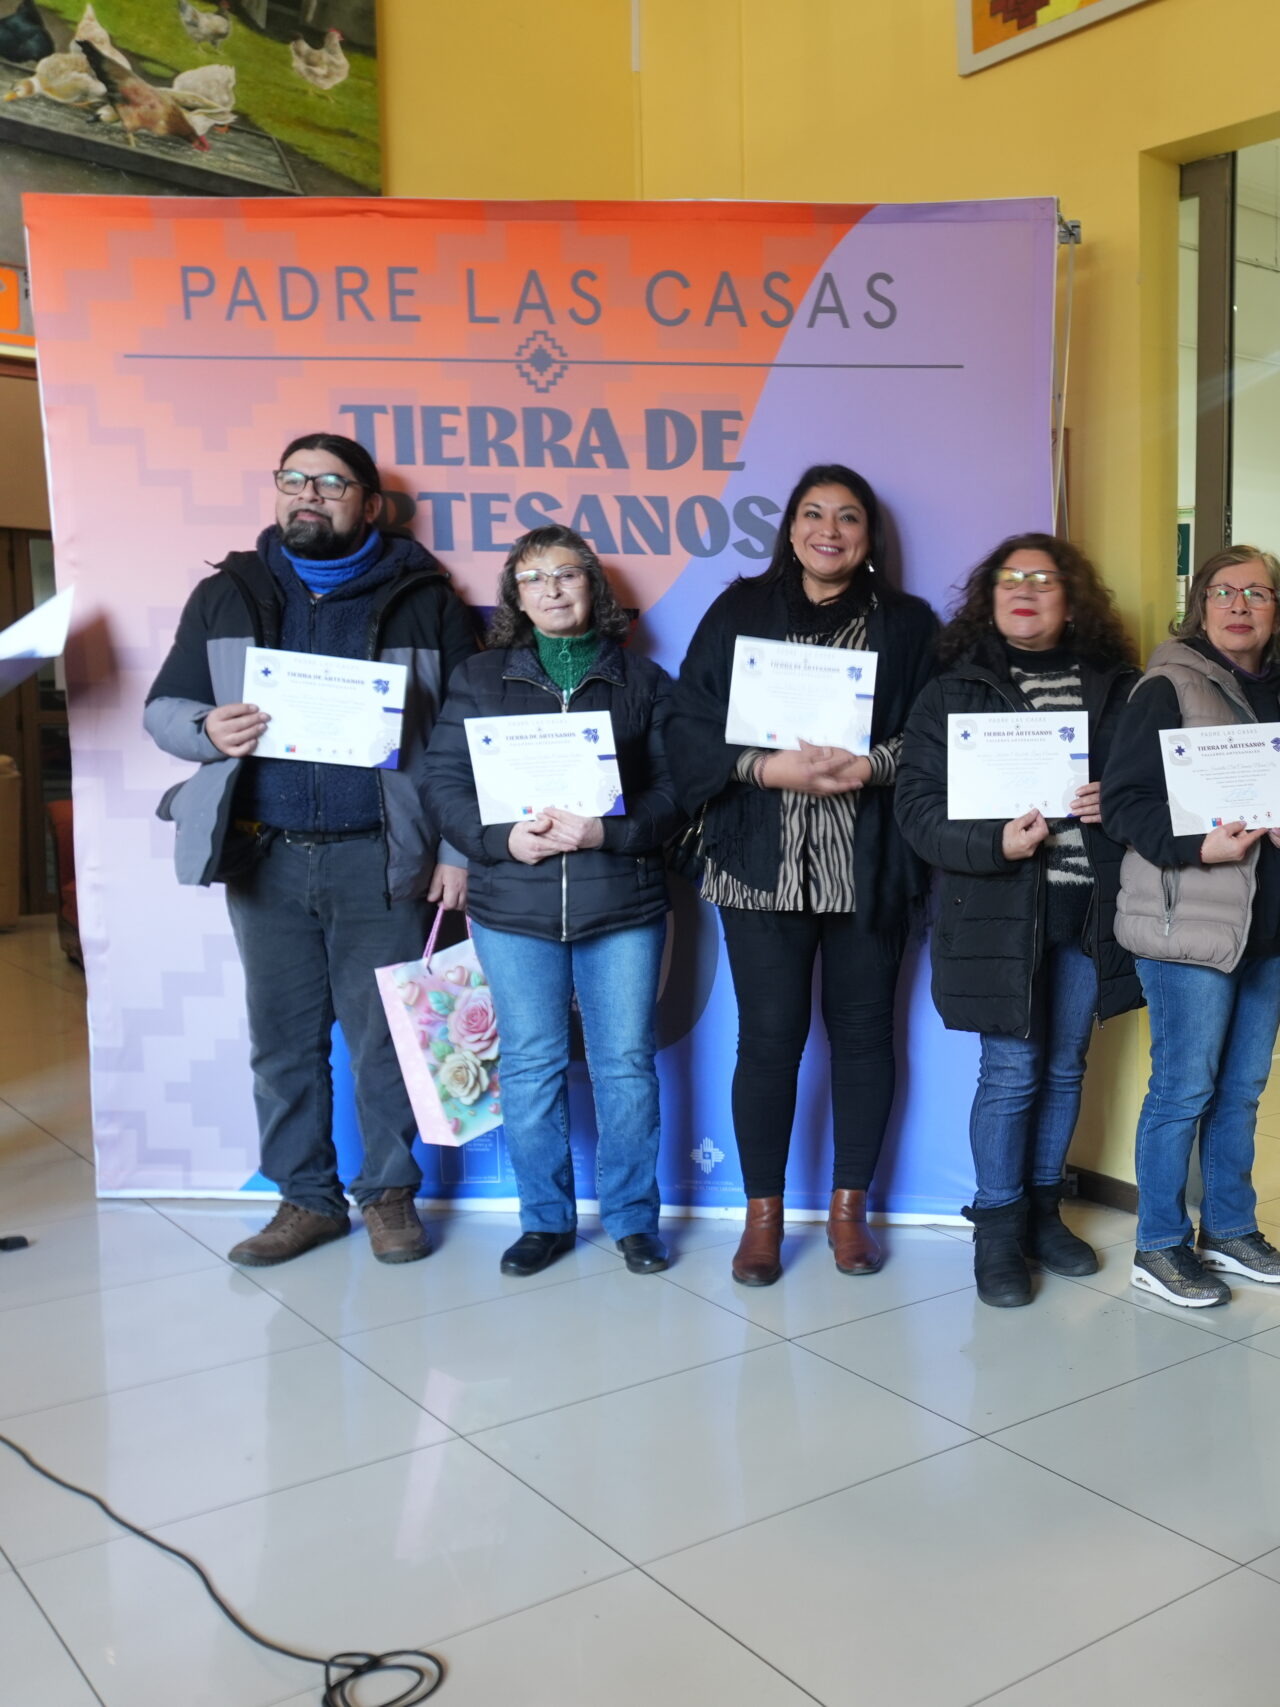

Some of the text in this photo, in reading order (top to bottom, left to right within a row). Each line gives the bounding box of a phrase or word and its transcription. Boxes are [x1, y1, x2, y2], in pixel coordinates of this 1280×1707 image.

[180, 265, 898, 329] PADRE LAS CASAS
[339, 403, 746, 471] TIERRA DE
[1197, 744, 1220, 752] TIERRA
